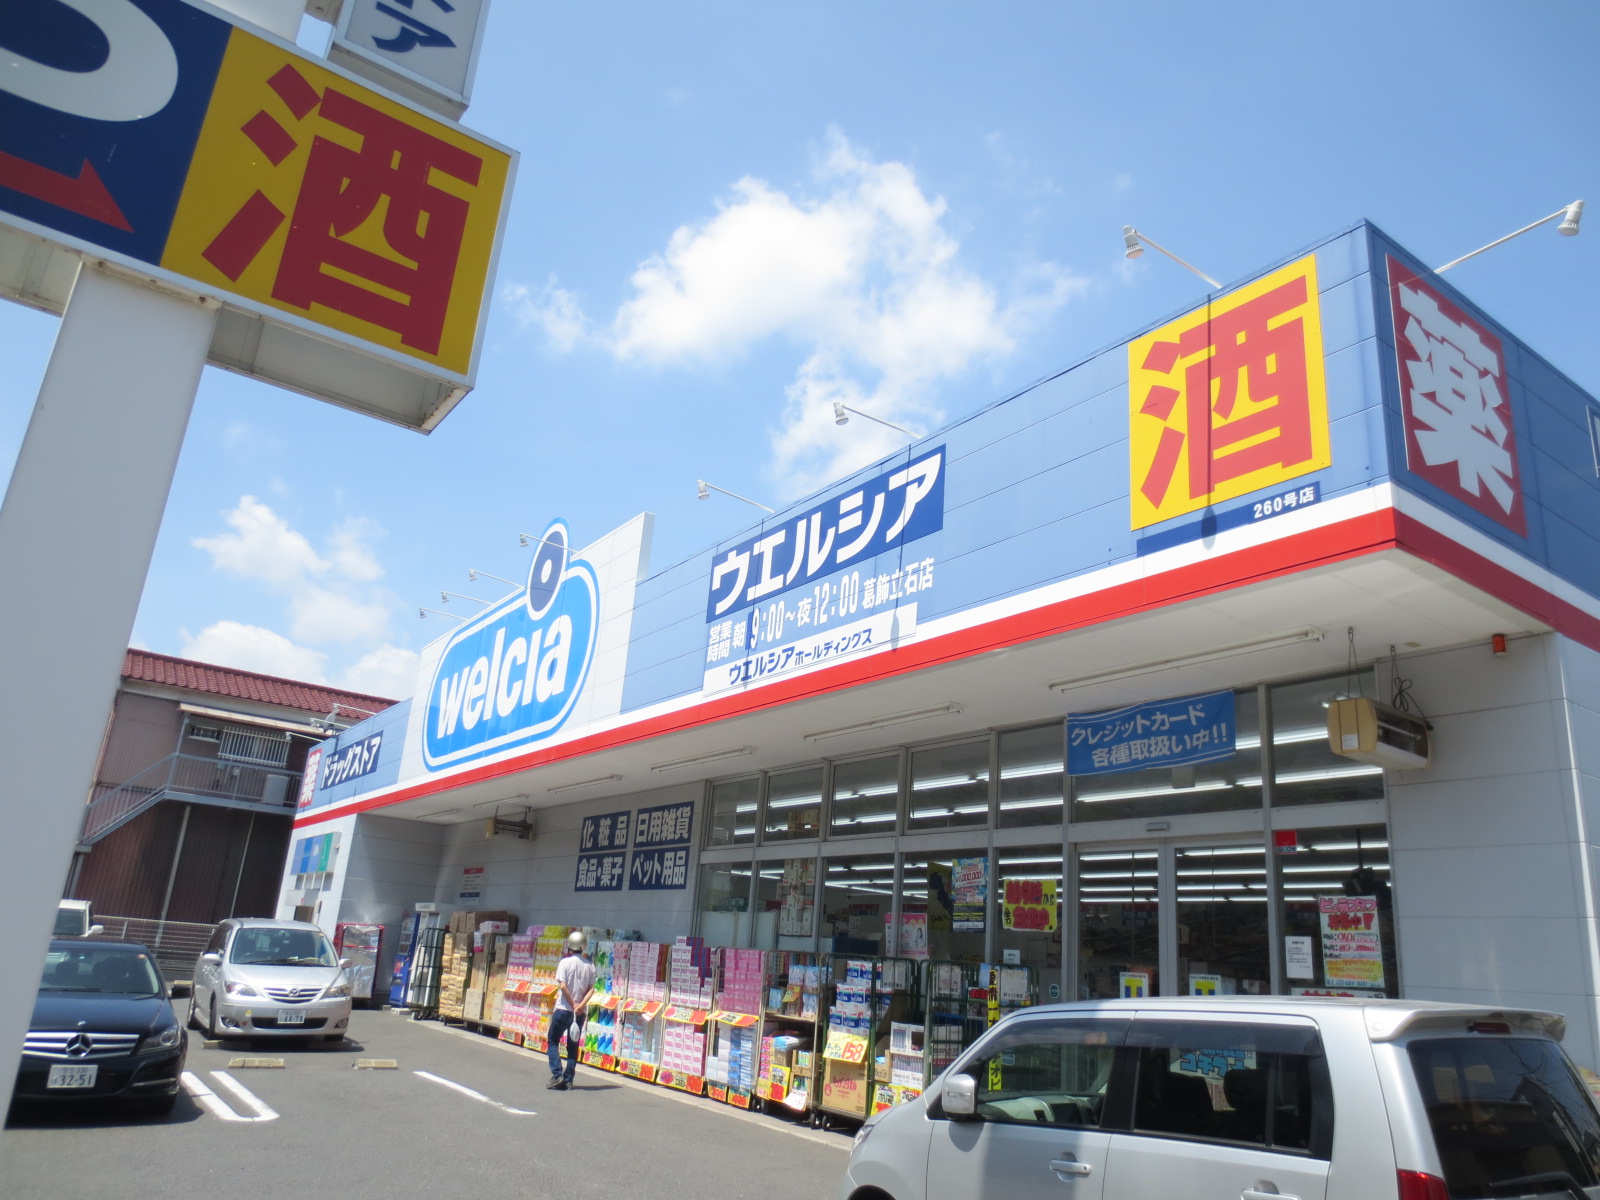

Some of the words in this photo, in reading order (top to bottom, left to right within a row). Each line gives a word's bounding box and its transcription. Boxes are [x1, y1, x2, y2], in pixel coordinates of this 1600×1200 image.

[201, 62, 484, 357] 酒
[1139, 274, 1313, 511] 酒
[1398, 282, 1515, 515] 薬
[1253, 486, 1315, 519] 260号店
[711, 452, 942, 616] ウエルシア
[862, 557, 935, 610] 葛飾立石店
[709, 619, 733, 644] 営業
[706, 641, 730, 664] 時間
[437, 614, 573, 740] welcia
[1071, 703, 1206, 747] クレジットカード
[320, 735, 381, 789] ドラッグストア
[582, 815, 628, 849] 化粧品
[636, 806, 692, 844] 日用雑貨
[632, 851, 687, 886] ペット用品
[284, 1015, 304, 1023] 44-78
[841, 1040, 864, 1062] 158
[60, 1074, 93, 1086] 32-51
